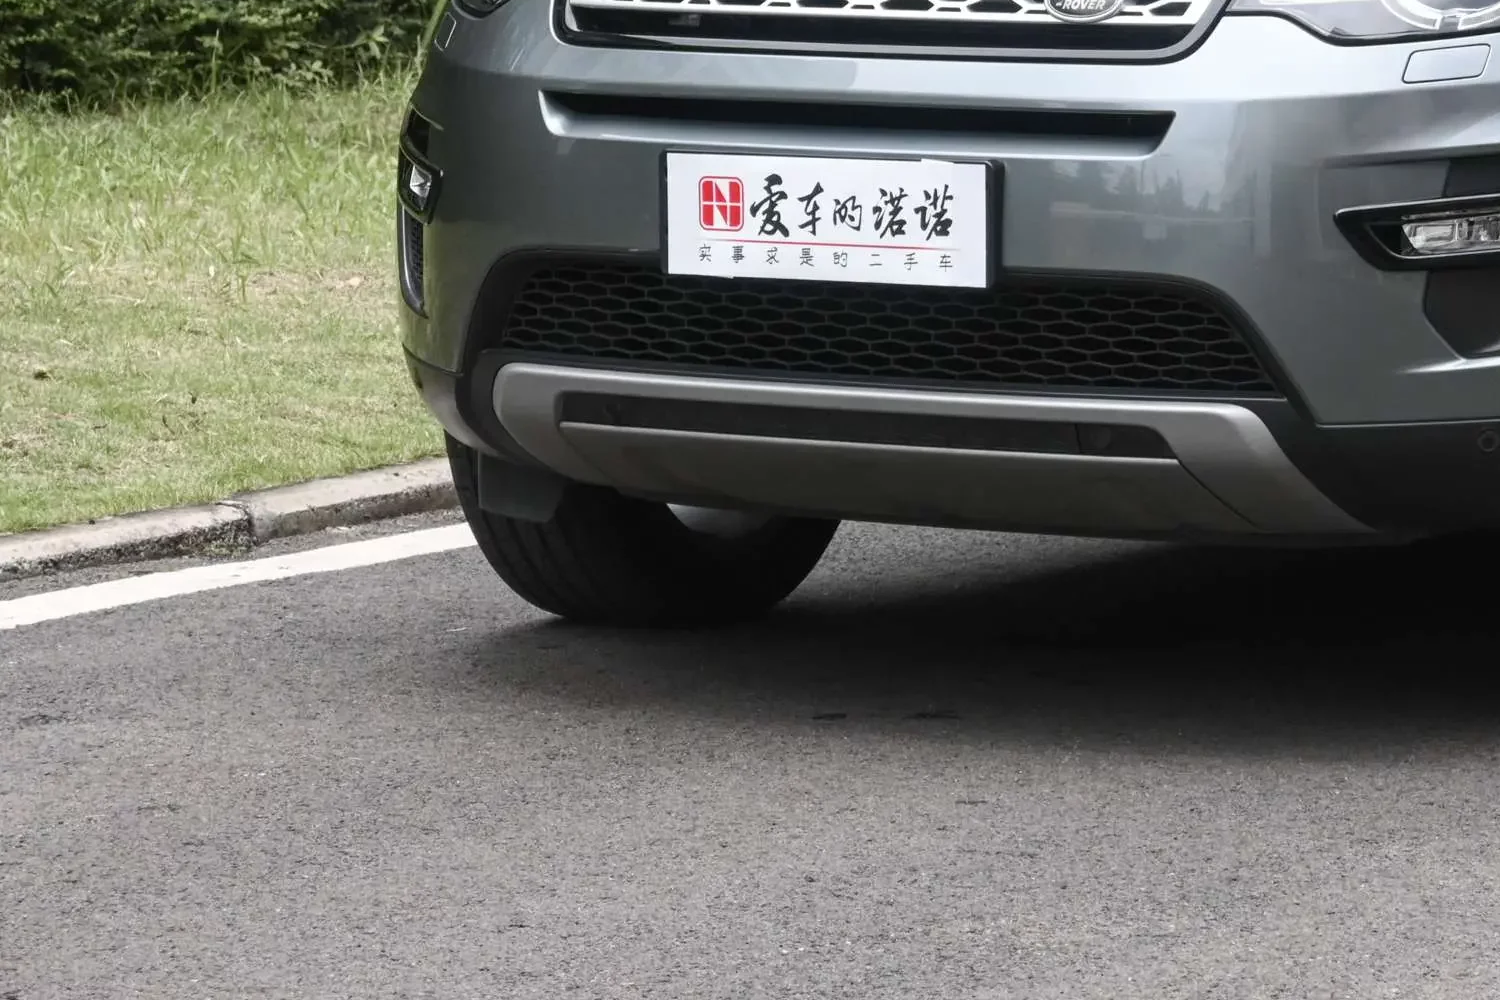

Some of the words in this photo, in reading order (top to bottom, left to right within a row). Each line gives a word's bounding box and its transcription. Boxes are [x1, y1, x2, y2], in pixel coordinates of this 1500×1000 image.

[698, 242, 954, 272] 实事求是的二手车
